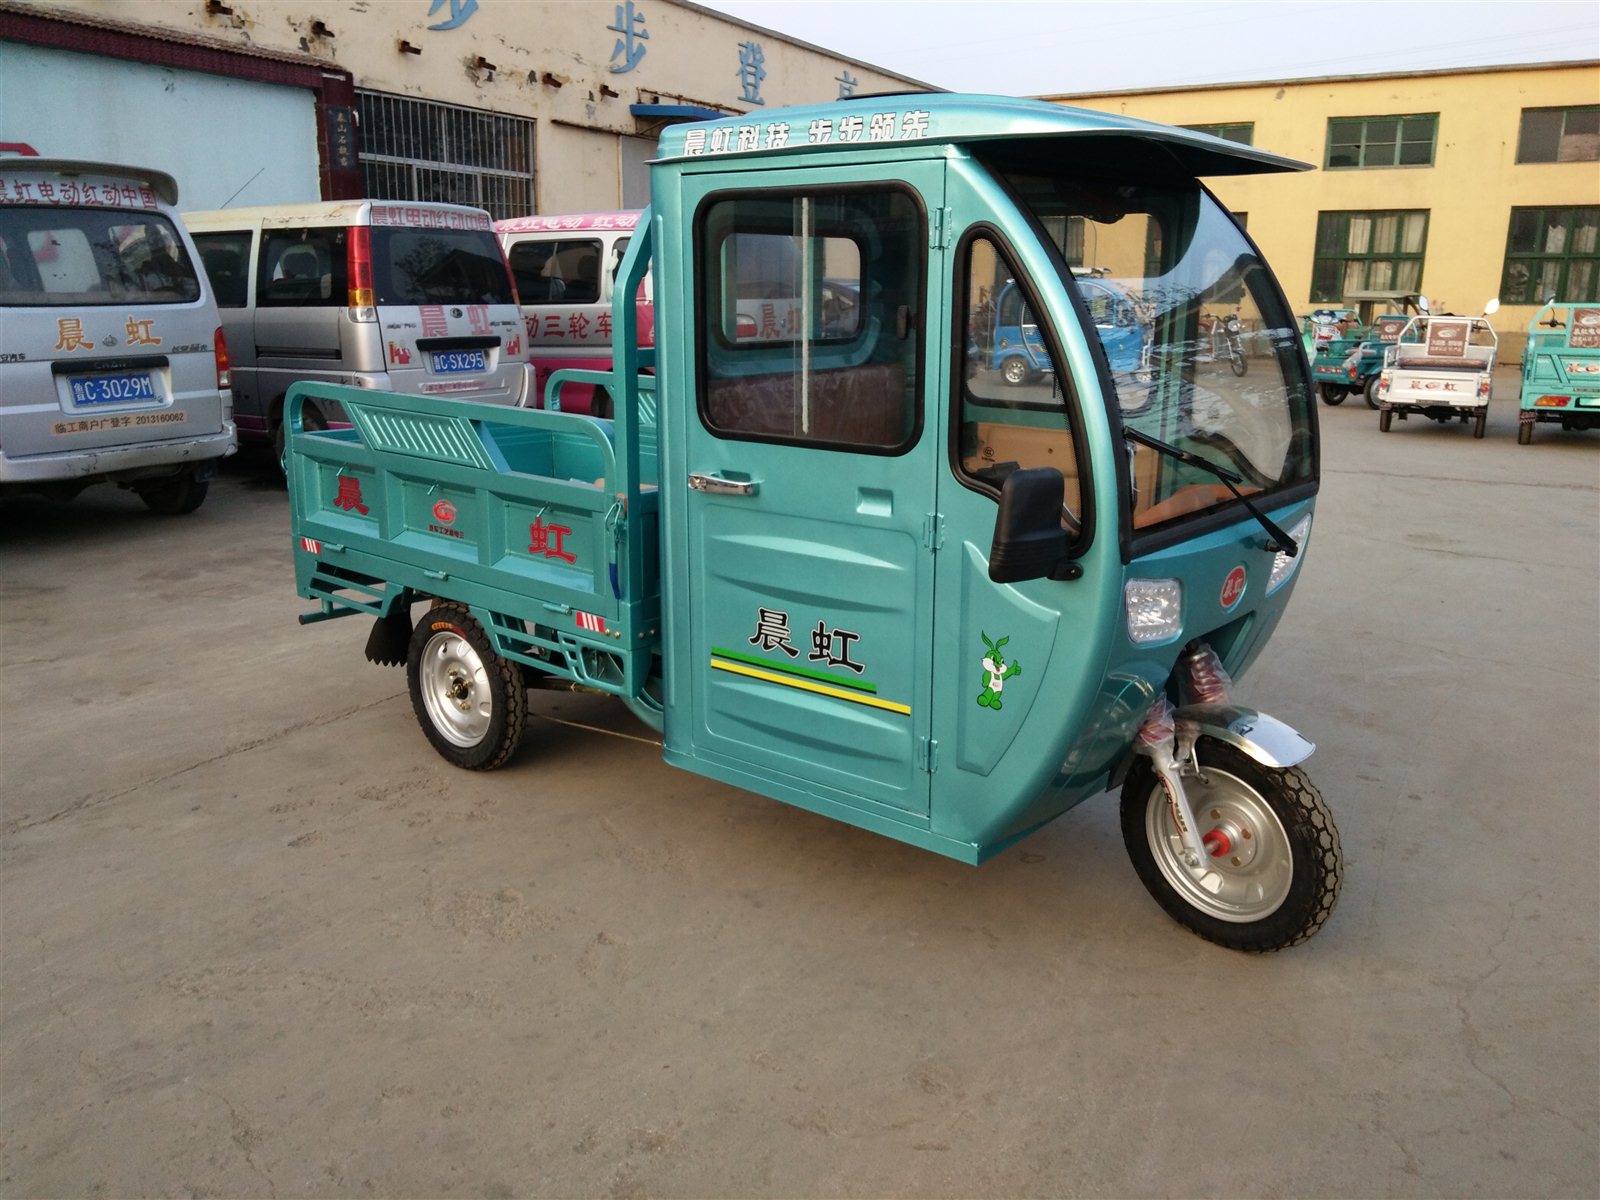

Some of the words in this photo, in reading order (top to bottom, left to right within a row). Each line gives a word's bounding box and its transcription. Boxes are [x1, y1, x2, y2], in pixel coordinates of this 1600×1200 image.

[683, 122, 791, 157] 晨虹科技
[808, 110, 931, 144] 步步领先
[747, 607, 866, 674] 晨虹
